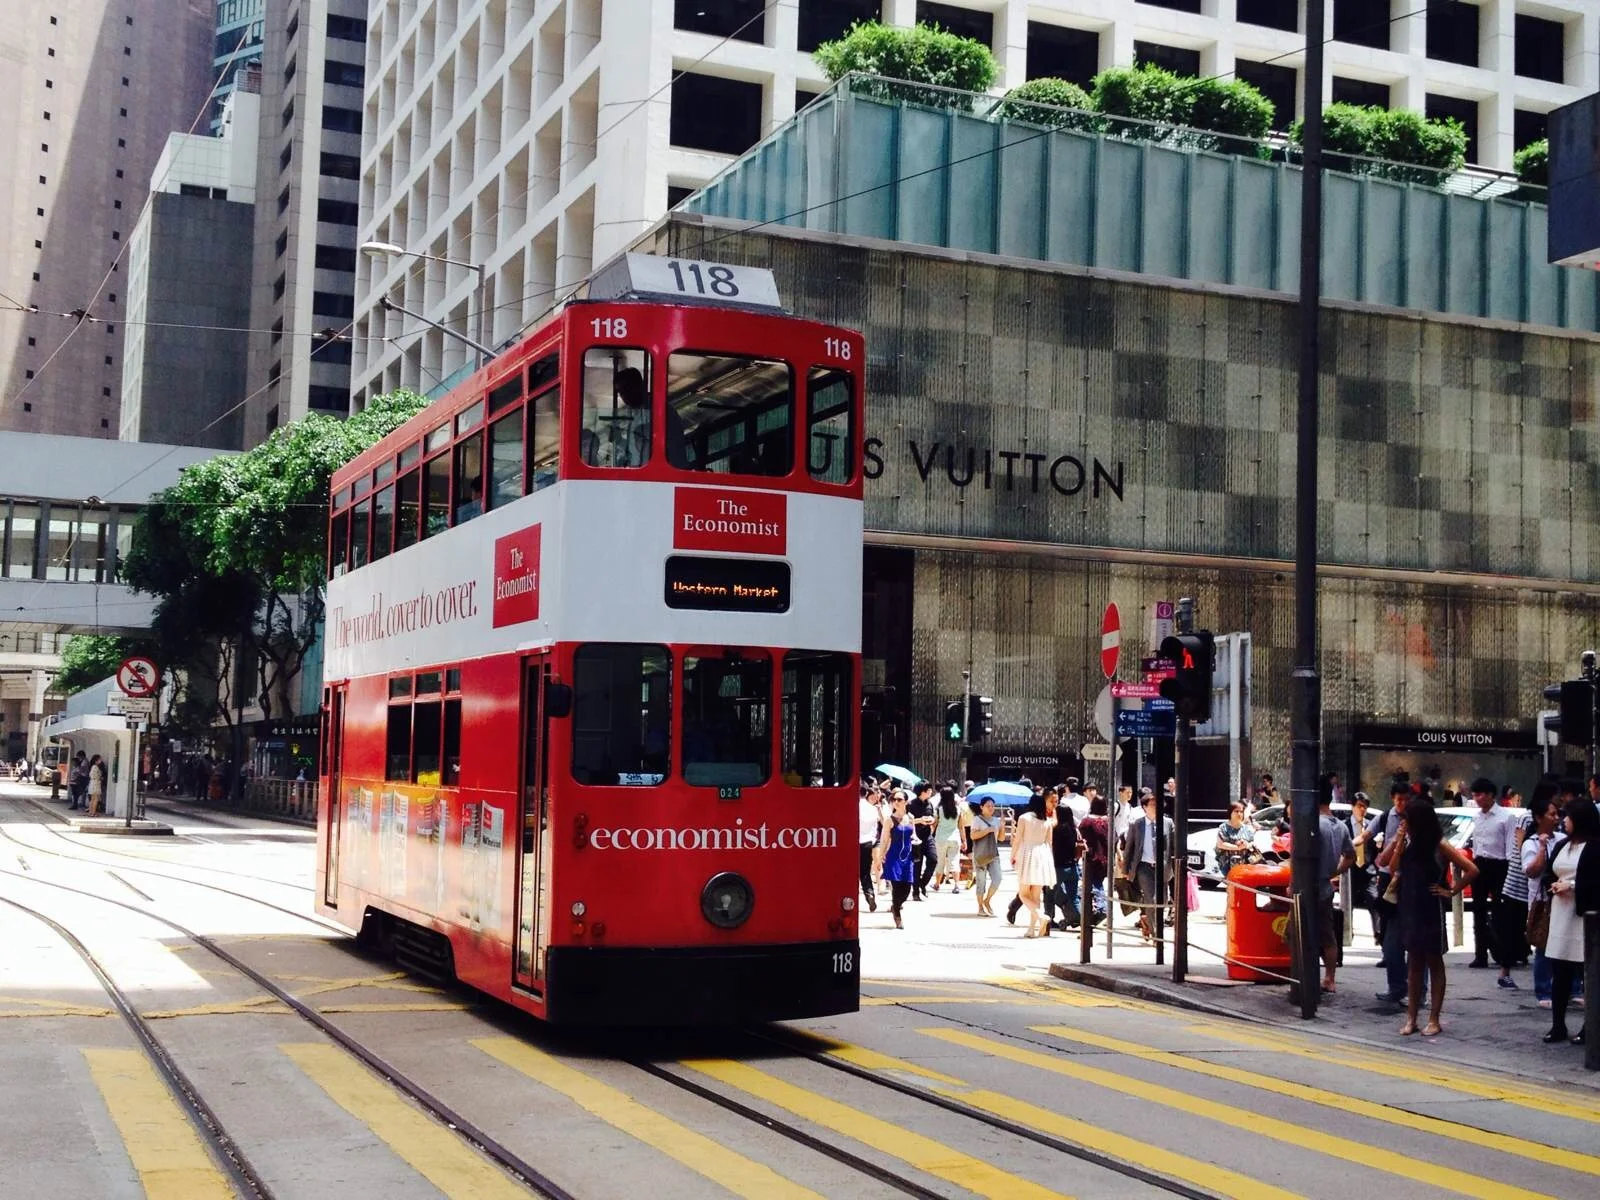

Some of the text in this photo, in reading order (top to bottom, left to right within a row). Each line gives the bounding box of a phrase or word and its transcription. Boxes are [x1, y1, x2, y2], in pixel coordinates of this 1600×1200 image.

[667, 260, 740, 297] 118
[590, 318, 628, 339] 118
[824, 337, 851, 361] 118
[909, 440, 1124, 501] VUITTON
[716, 499, 748, 517] The
[683, 514, 780, 537] Economist
[510, 547, 524, 570] The
[496, 567, 537, 600] Economist
[733, 584, 779, 598] Market
[333, 580, 477, 649] The world. cover to cover.
[1417, 732, 1493, 744] LOUIS VUITTON
[999, 755, 1059, 765] LOUIS VUITTON
[590, 817, 838, 850] economist.com
[832, 951, 853, 974] 118
